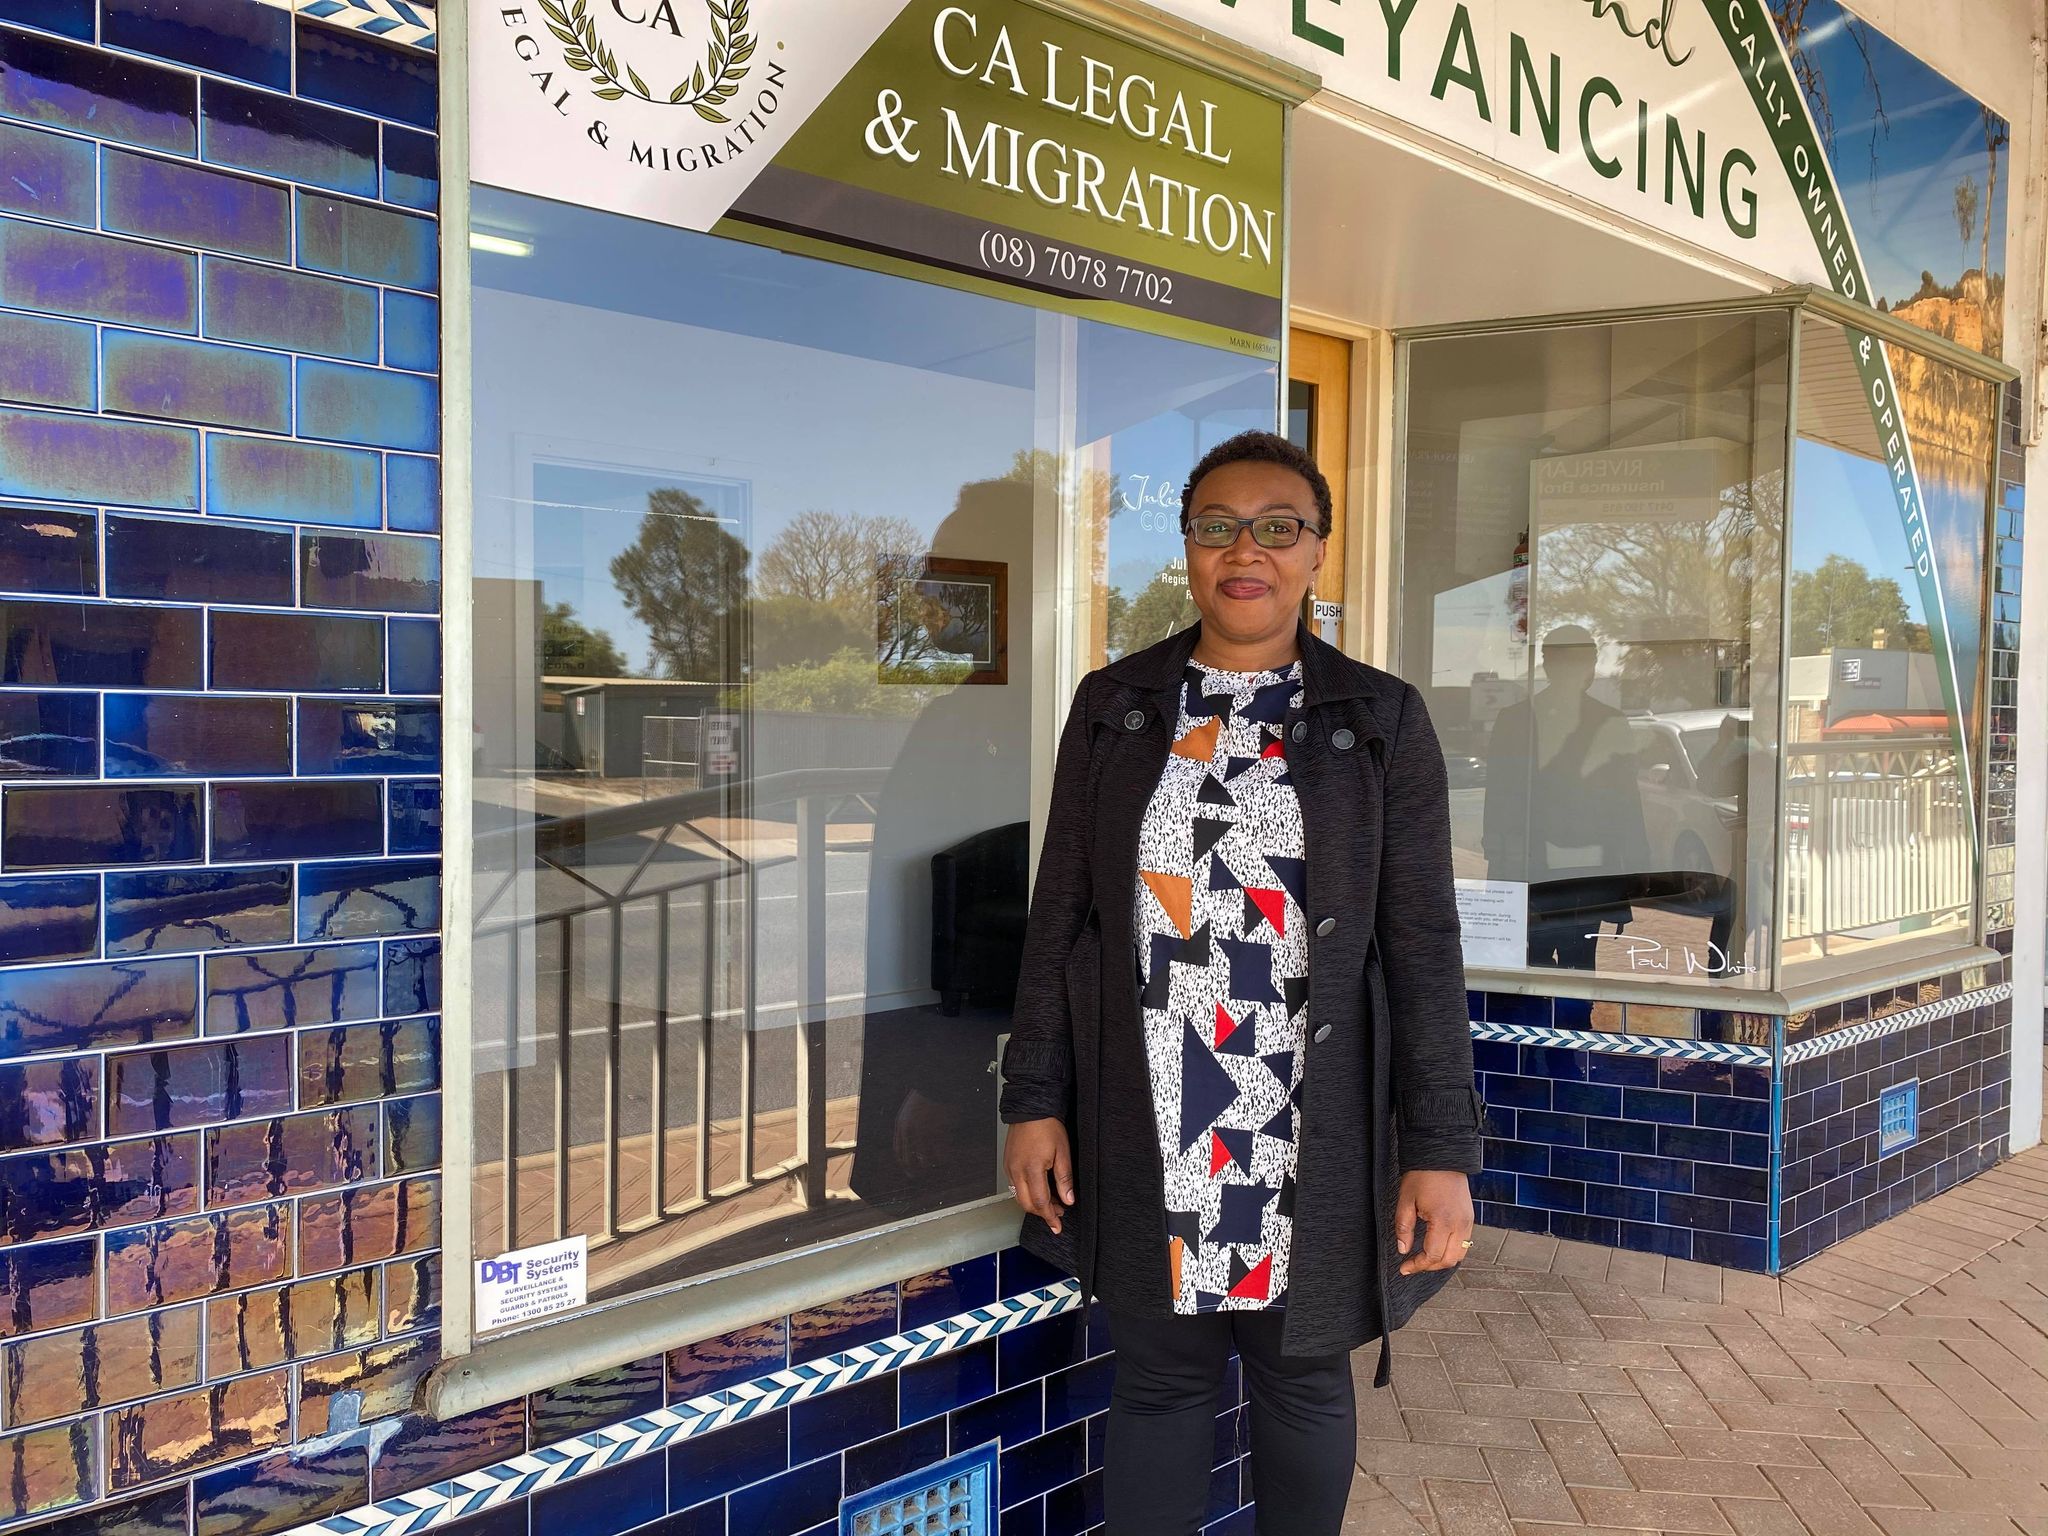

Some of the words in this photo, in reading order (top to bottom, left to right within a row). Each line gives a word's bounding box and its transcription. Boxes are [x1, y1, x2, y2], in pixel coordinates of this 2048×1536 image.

[933, 6, 1029, 97] CA
[1041, 40, 1232, 165] LEGAL
[587, 119, 609, 151] &
[628, 60, 788, 173] MIGRATION
[864, 88, 921, 163] &
[940, 106, 1276, 265] MIGRATION
[979, 229, 1036, 278] (08)
[1044, 246, 1107, 288] 7078
[1115, 265, 1174, 305] 7702
[1229, 335, 1251, 349] MARN
[1793, 144, 1856, 300] OWNED
[1859, 335, 1872, 367] &
[1872, 377, 1930, 578] OPERATED
[1315, 604, 1343, 618] PUSH
[1584, 932, 1671, 972] Paul
[1683, 940, 1757, 975] White
[481, 1260, 523, 1285] DBT
[526, 1249, 580, 1270] Security
[526, 1260, 580, 1281] Systems
[499, 1300, 530, 1314] GUARDS
[538, 1291, 569, 1304] PATROLS
[500, 1291, 536, 1306] SECURITY
[536, 1283, 569, 1296] SYSTEMS
[504, 1277, 557, 1296] SURVEILLANCE
[491, 1312, 520, 1326] Phone:
[521, 1306, 542, 1318] 1300
[543, 1304, 554, 1313] 85
[555, 1301, 565, 1310] 25
[566, 1298, 577, 1307] 27
